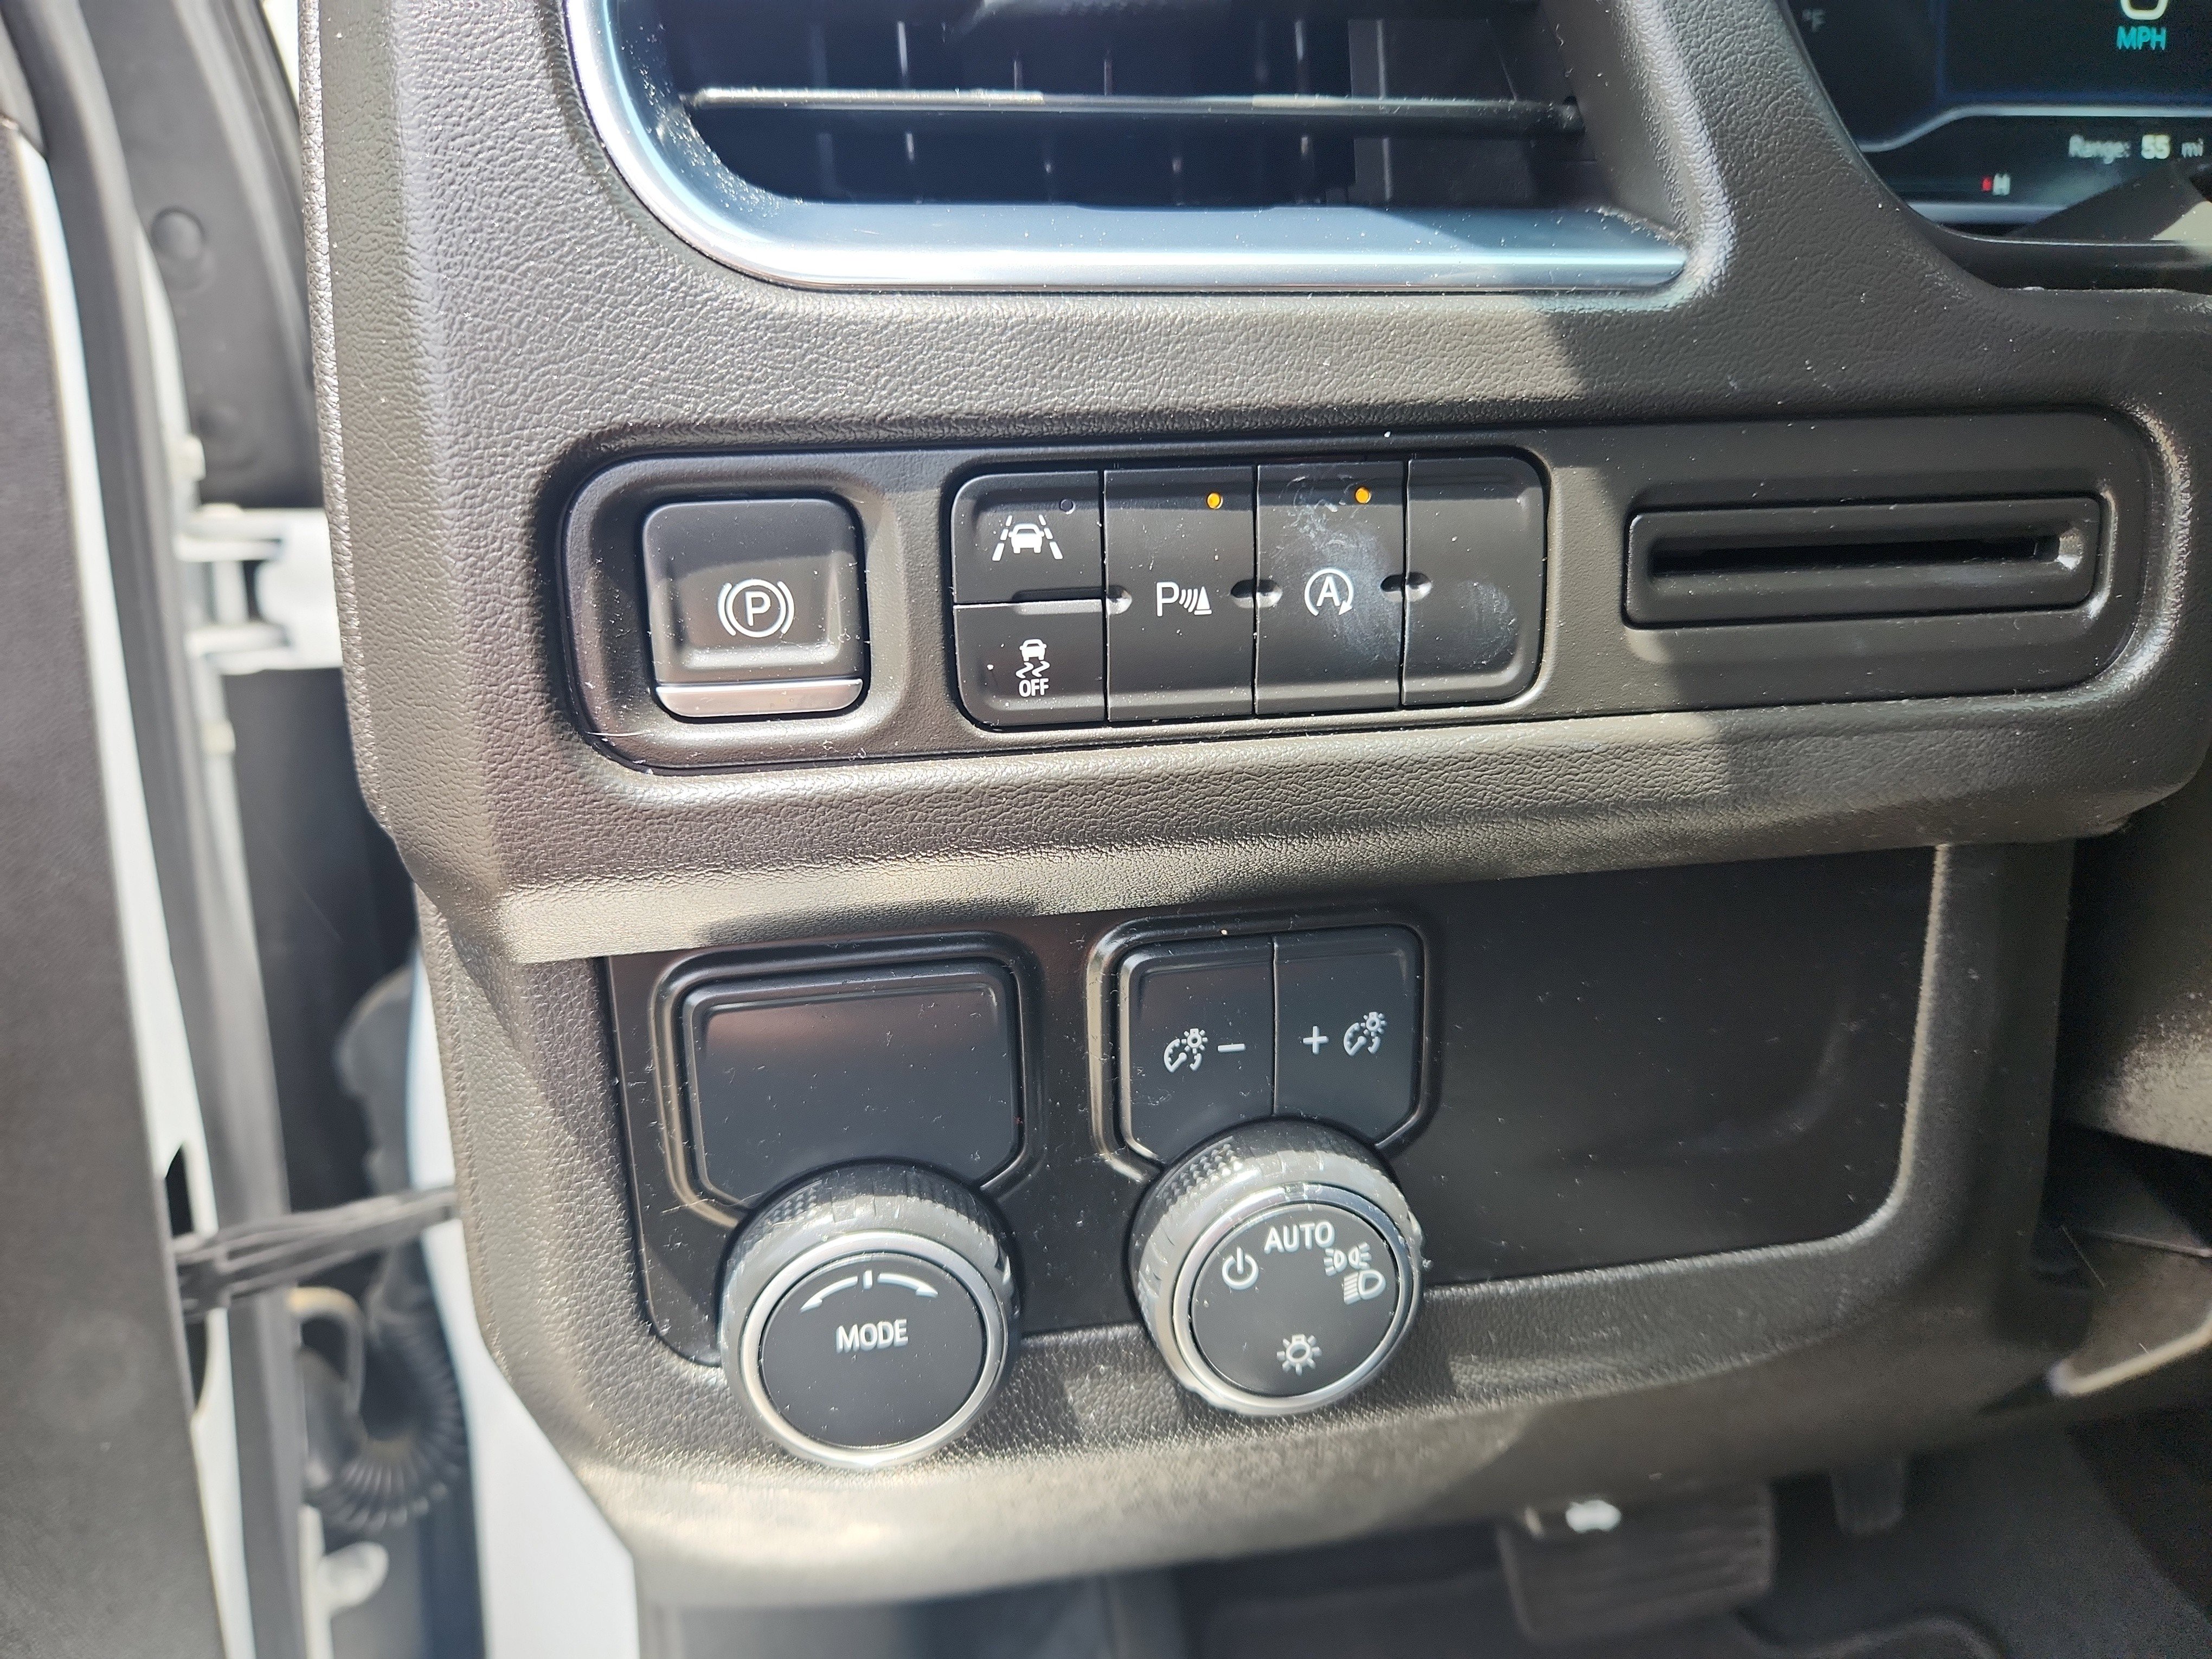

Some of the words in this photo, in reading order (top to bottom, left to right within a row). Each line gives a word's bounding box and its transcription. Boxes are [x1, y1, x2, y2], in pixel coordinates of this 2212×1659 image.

[2117, 25, 2166, 51] MPH
[2068, 133, 2132, 164] Range:
[2141, 134, 2170, 159] 55
[2181, 138, 2204, 158] mi
[744, 590, 771, 627] P
[1156, 581, 1179, 617] P
[1019, 678, 1049, 697] OFF
[1264, 1221, 1335, 1254] AUTO
[835, 1319, 909, 1353] MODE
